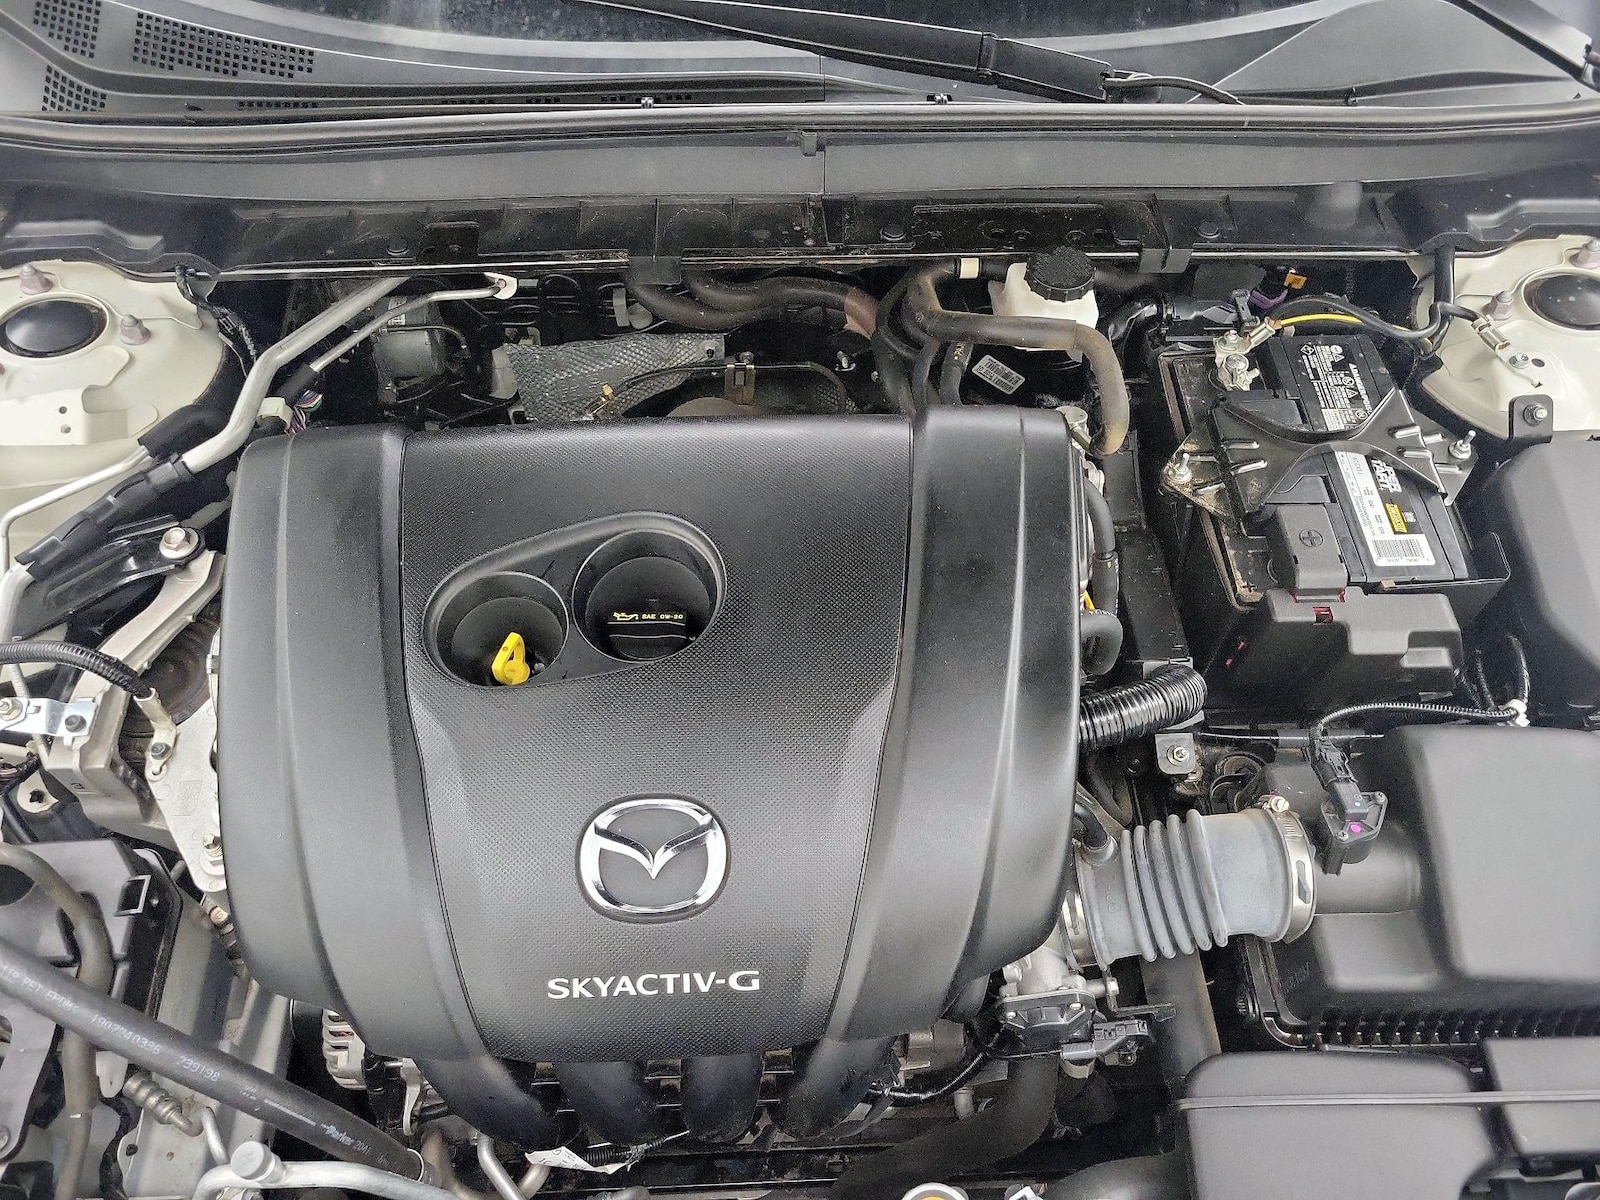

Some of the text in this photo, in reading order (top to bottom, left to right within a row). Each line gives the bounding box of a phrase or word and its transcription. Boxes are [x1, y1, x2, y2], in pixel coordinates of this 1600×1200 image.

[1371, 459, 1389, 490] TART
[1381, 461, 1402, 493] UPER
[547, 970, 760, 999] SKYACTIV-G
[325, 1124, 355, 1146] Parker
